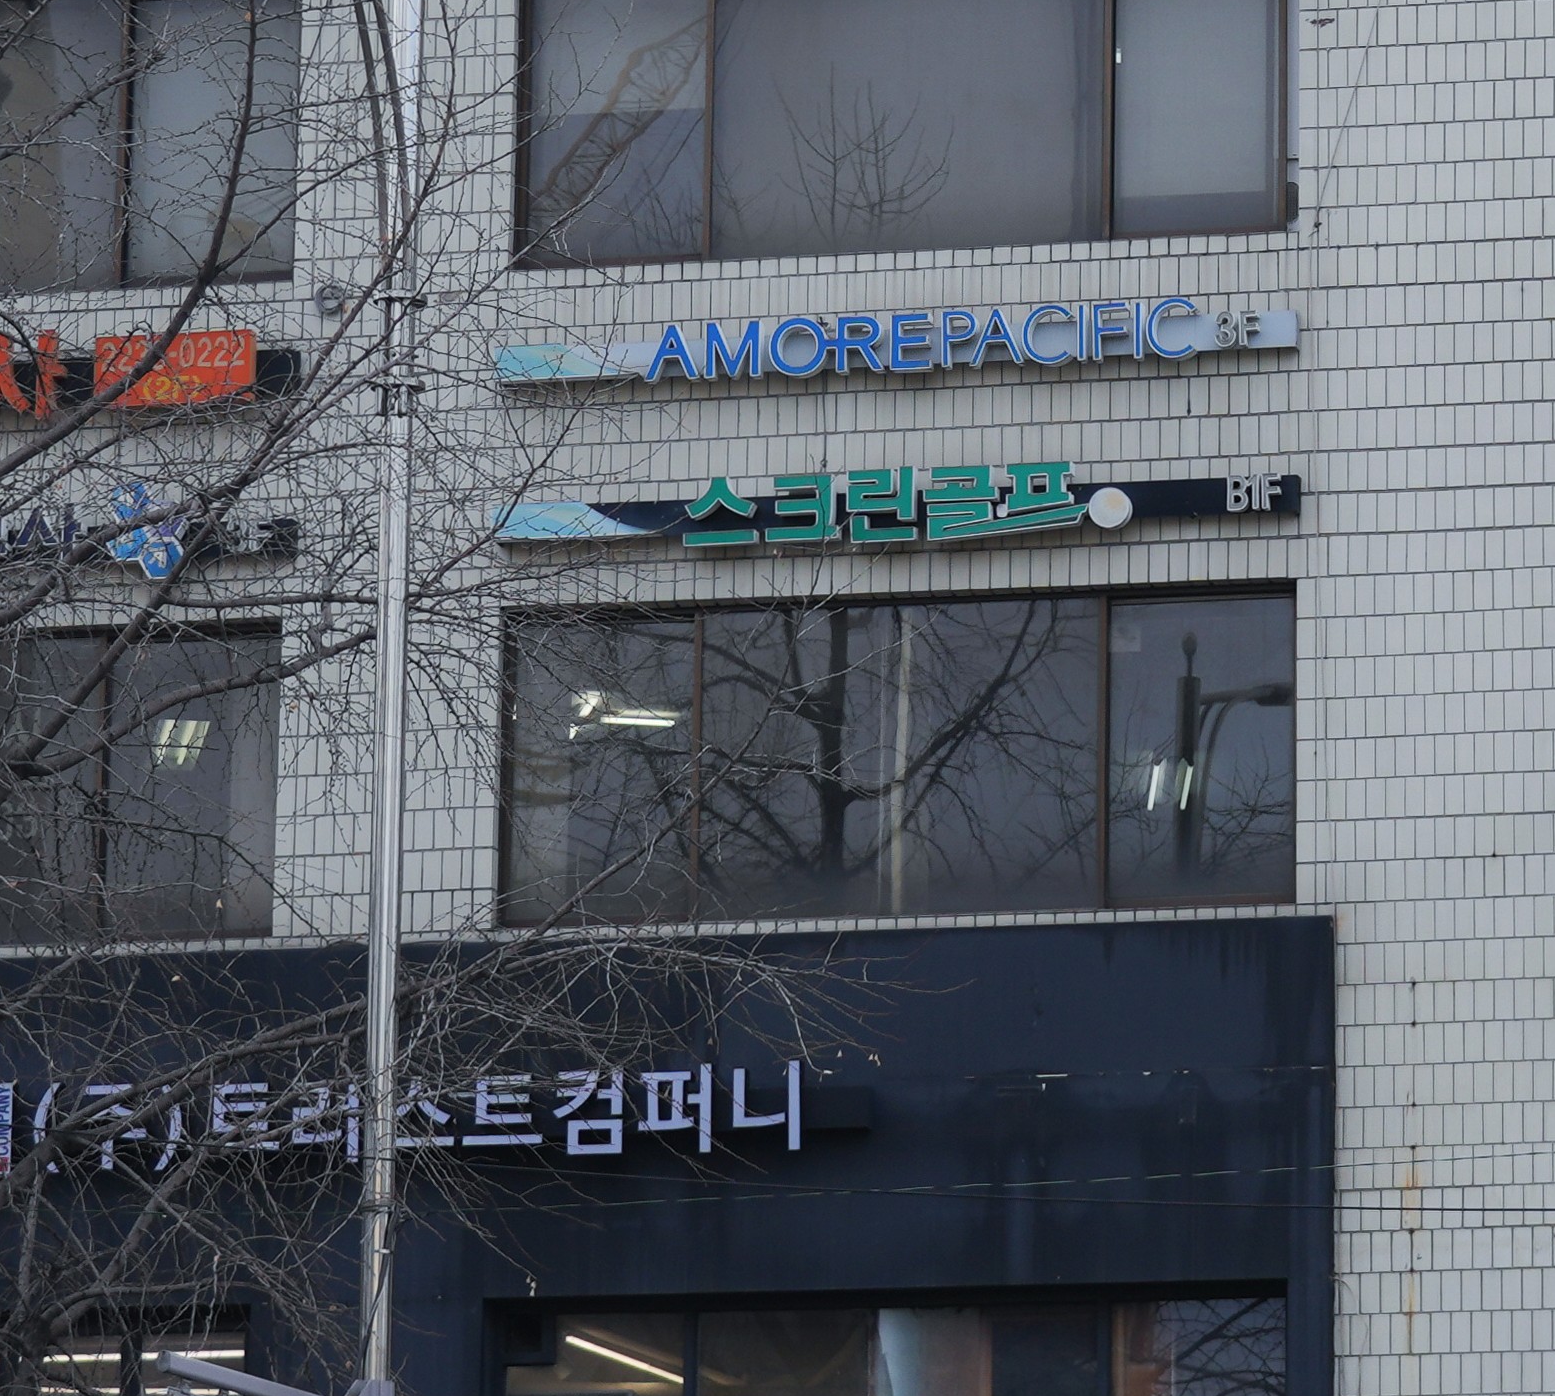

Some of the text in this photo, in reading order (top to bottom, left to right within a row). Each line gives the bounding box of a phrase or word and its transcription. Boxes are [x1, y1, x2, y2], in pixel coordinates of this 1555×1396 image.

[646, 297, 1262, 382] AMOREPACIFIC 3F
[683, 461, 1283, 547] 스크린골프 B1F
